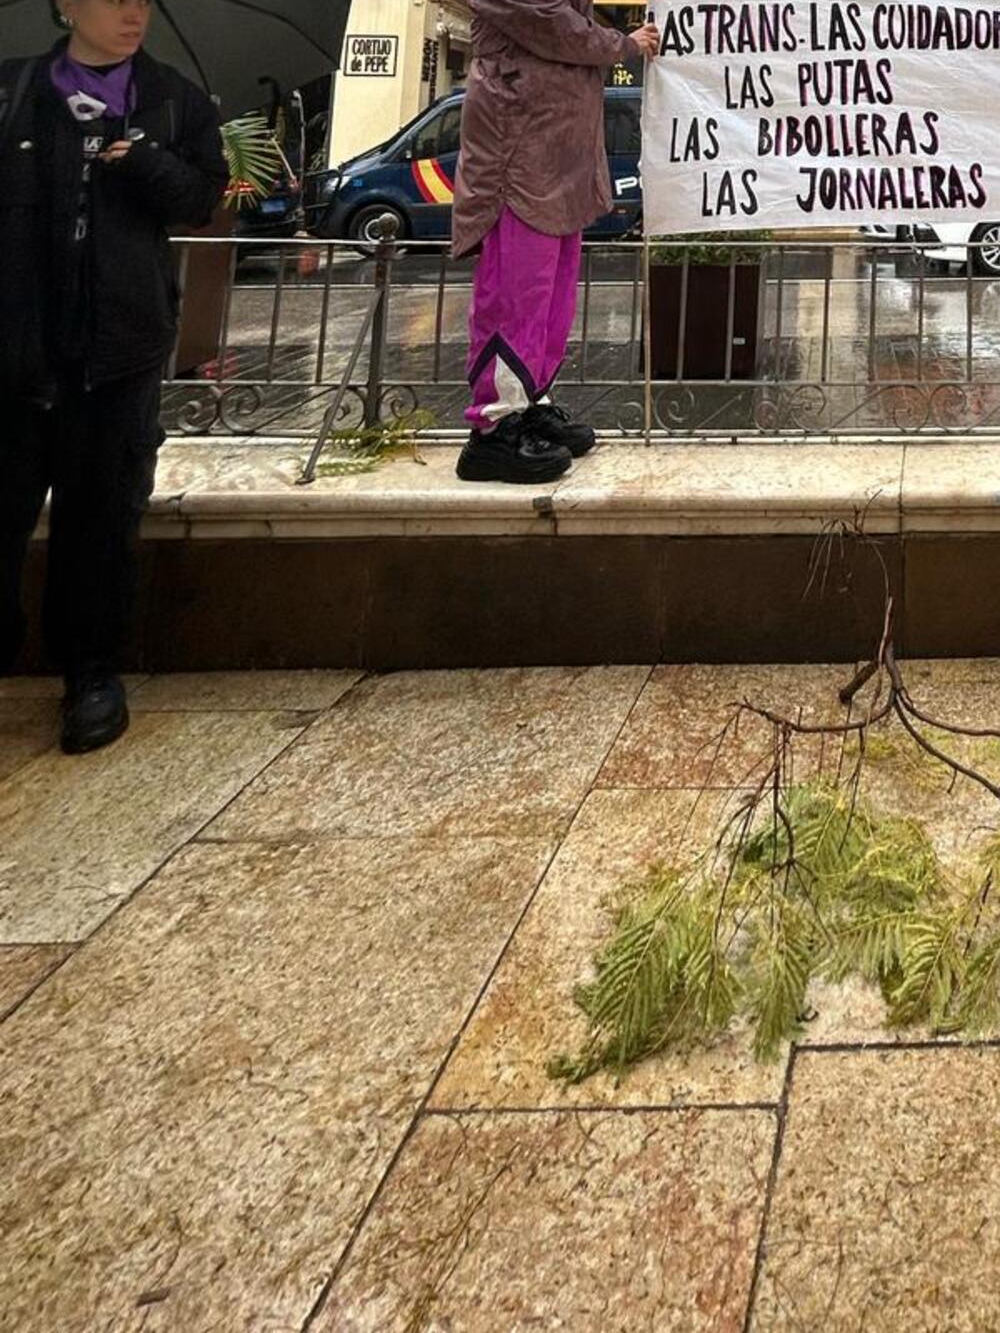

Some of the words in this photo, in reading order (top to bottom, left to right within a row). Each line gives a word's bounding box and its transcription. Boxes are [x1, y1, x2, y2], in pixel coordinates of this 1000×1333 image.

[648, 5, 694, 56] AS
[810, 2, 866, 52] LAS
[365, 56, 389, 72] PEPE
[725, 65, 774, 109] LAS
[799, 58, 893, 107] PUTAS
[669, 118, 719, 162] LAS
[757, 111, 939, 157] BIBOLLERAS
[701, 169, 758, 216] LAS
[797, 163, 987, 212] JORNALERAS
